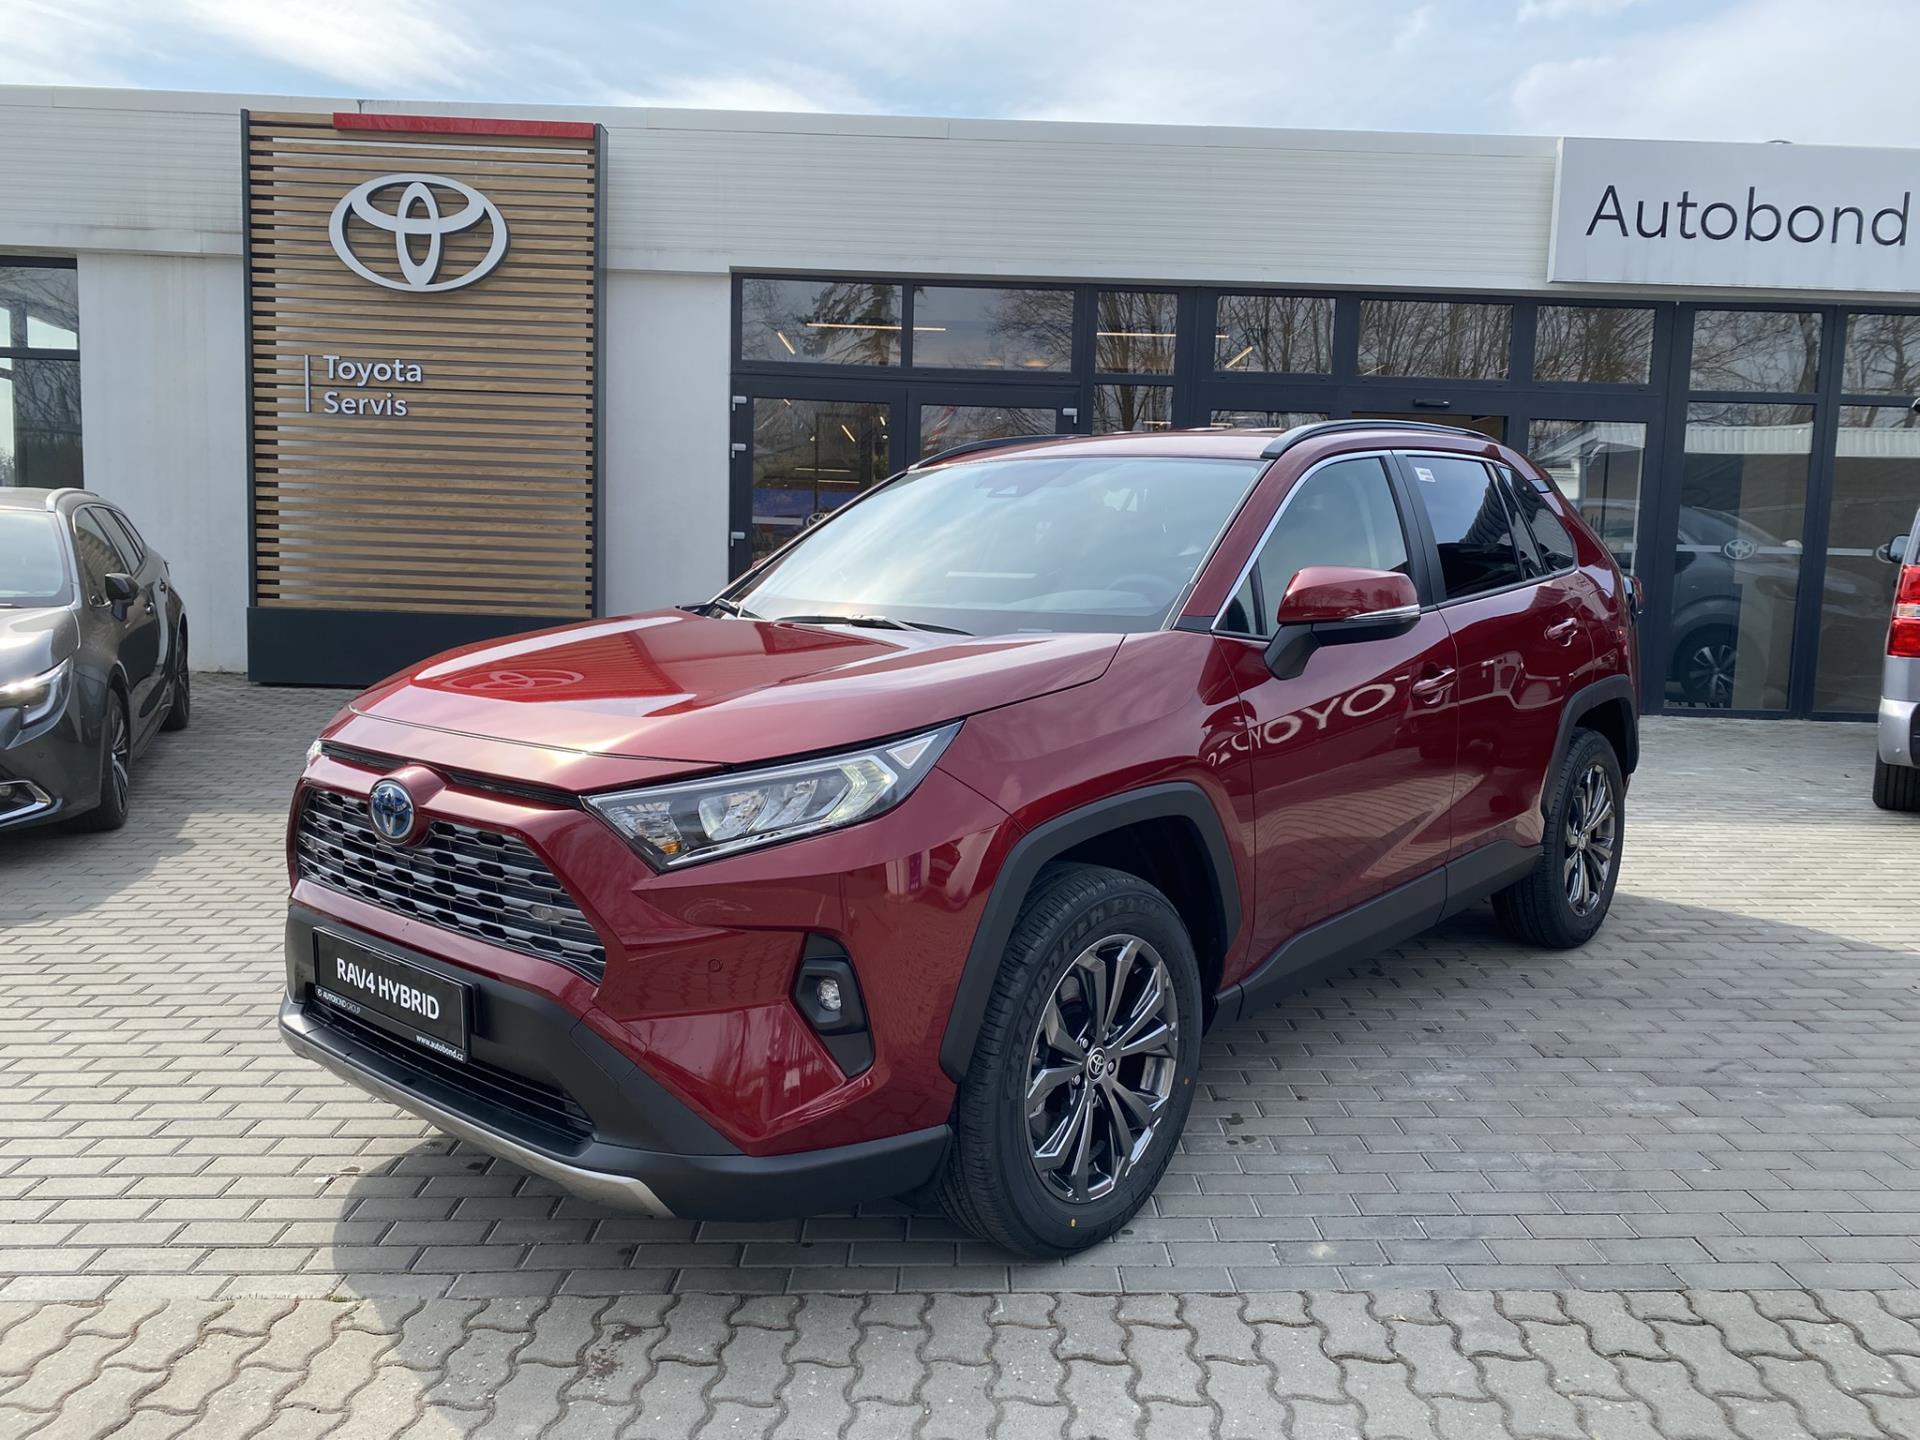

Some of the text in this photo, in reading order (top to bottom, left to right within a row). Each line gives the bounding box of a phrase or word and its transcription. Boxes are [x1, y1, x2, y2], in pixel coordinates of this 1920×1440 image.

[1586, 185, 1911, 246] Autobond
[322, 354, 422, 387] Toyota
[324, 391, 408, 417] Servis
[336, 957, 440, 1020] RAV4 HYBRID
[416, 1034, 464, 1062] www.autobond.cz
